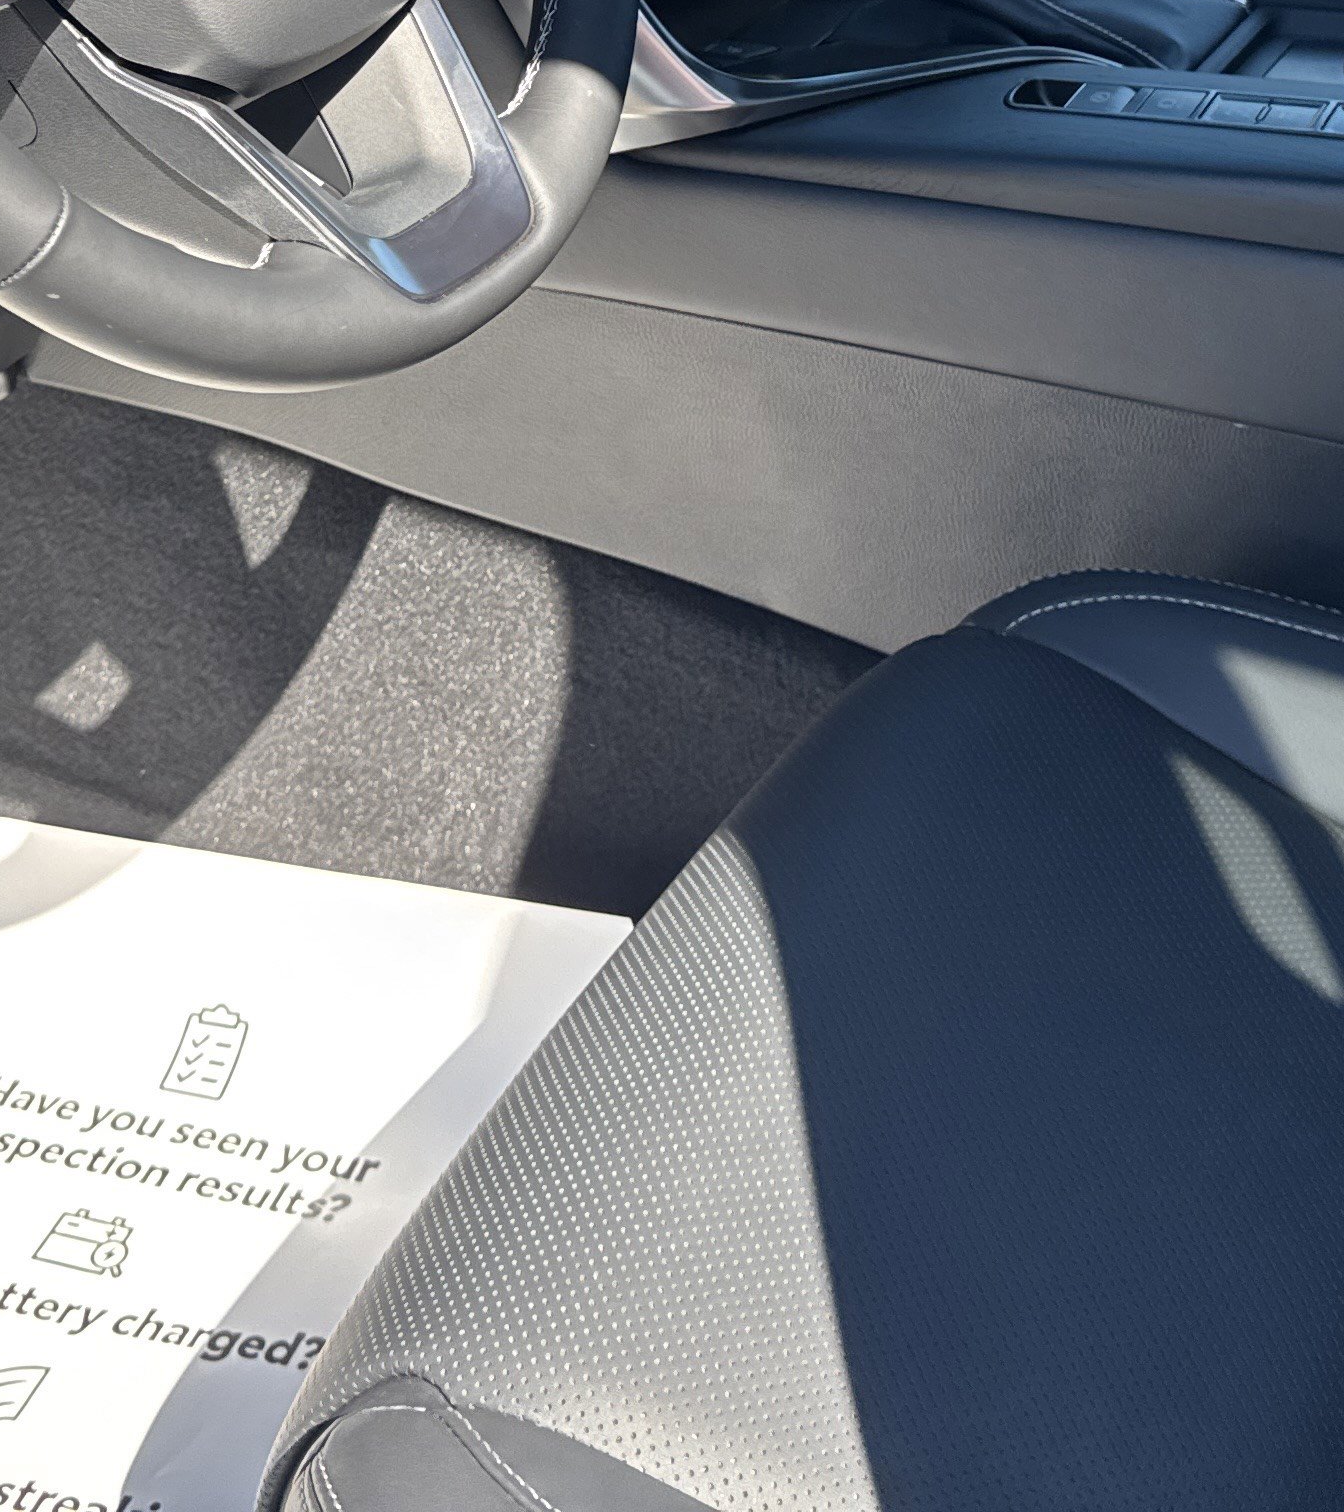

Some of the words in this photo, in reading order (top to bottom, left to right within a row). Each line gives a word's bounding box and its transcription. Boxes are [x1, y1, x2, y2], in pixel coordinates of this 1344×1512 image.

[79, 1103, 166, 1138] you
[169, 1122, 270, 1161] seen
[269, 1143, 382, 1183] your
[175, 1171, 352, 1223] results?
[111, 1304, 327, 1371] charged?
